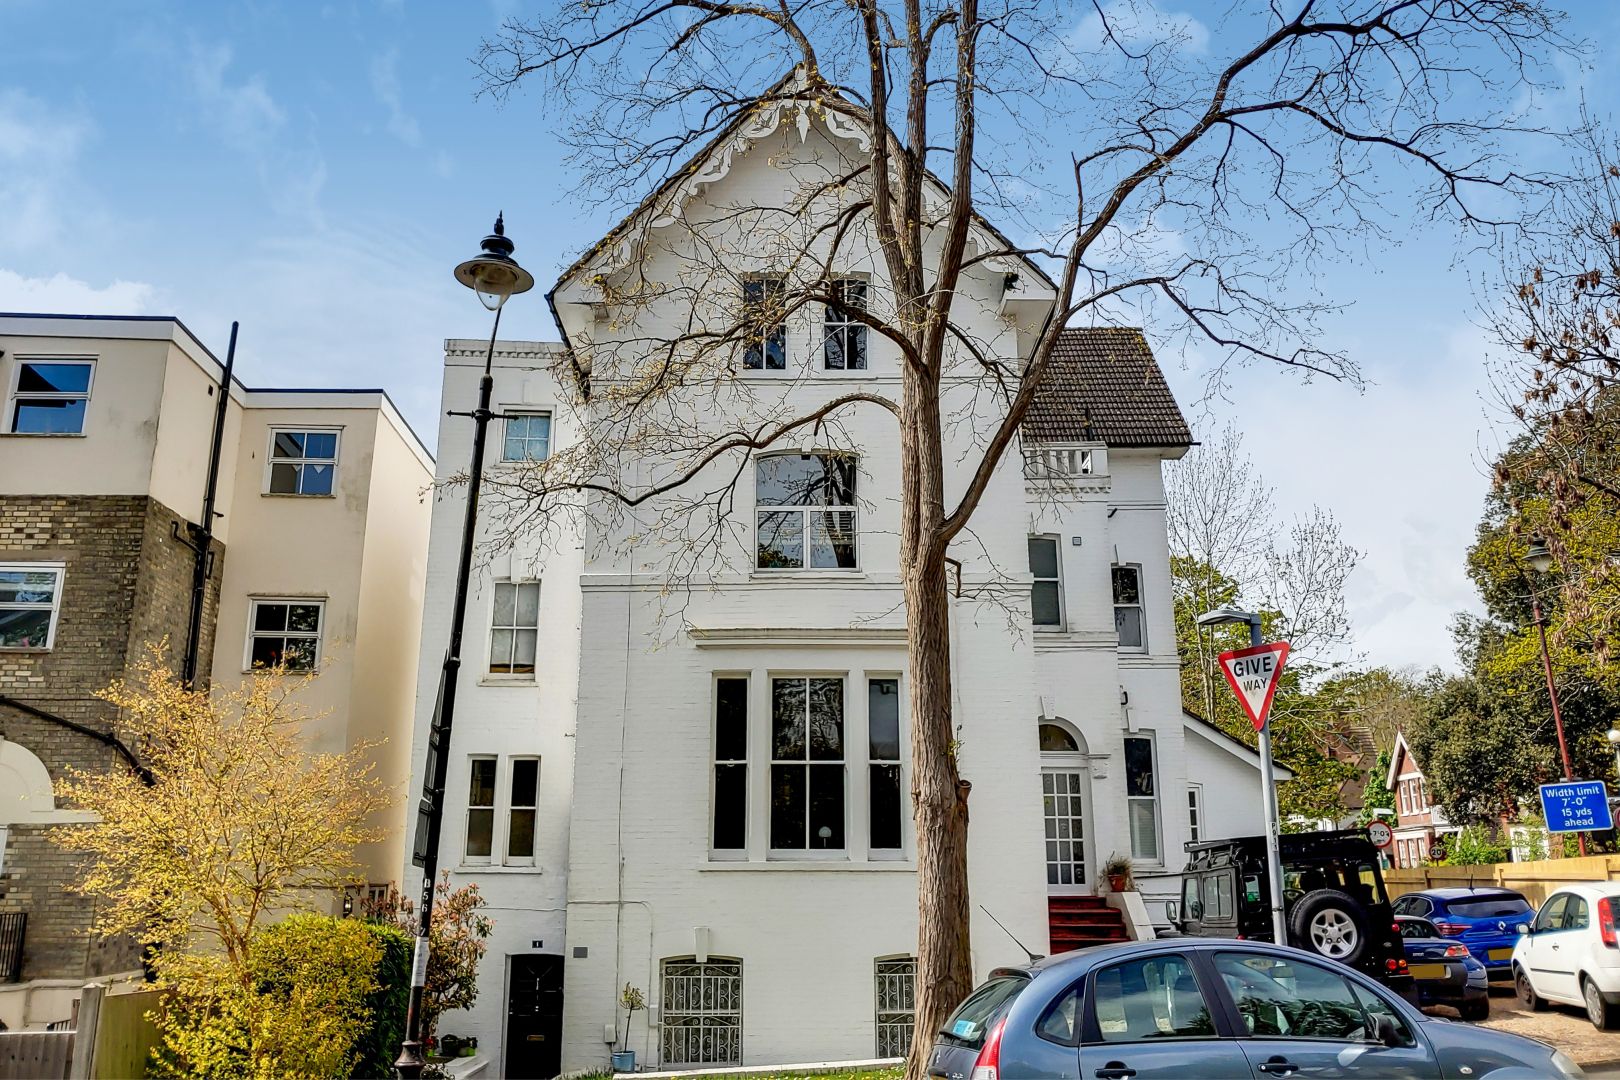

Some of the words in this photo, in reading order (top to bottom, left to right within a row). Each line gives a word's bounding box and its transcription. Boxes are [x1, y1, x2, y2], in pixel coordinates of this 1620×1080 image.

[1233, 656, 1272, 677] GIVE
[1243, 678, 1267, 692] WAY
[1545, 788, 1574, 798] Width
[1576, 786, 1600, 796] limit
[1561, 808, 1572, 817] 15
[1575, 807, 1593, 818] yds
[1564, 817, 1594, 827] ahead
